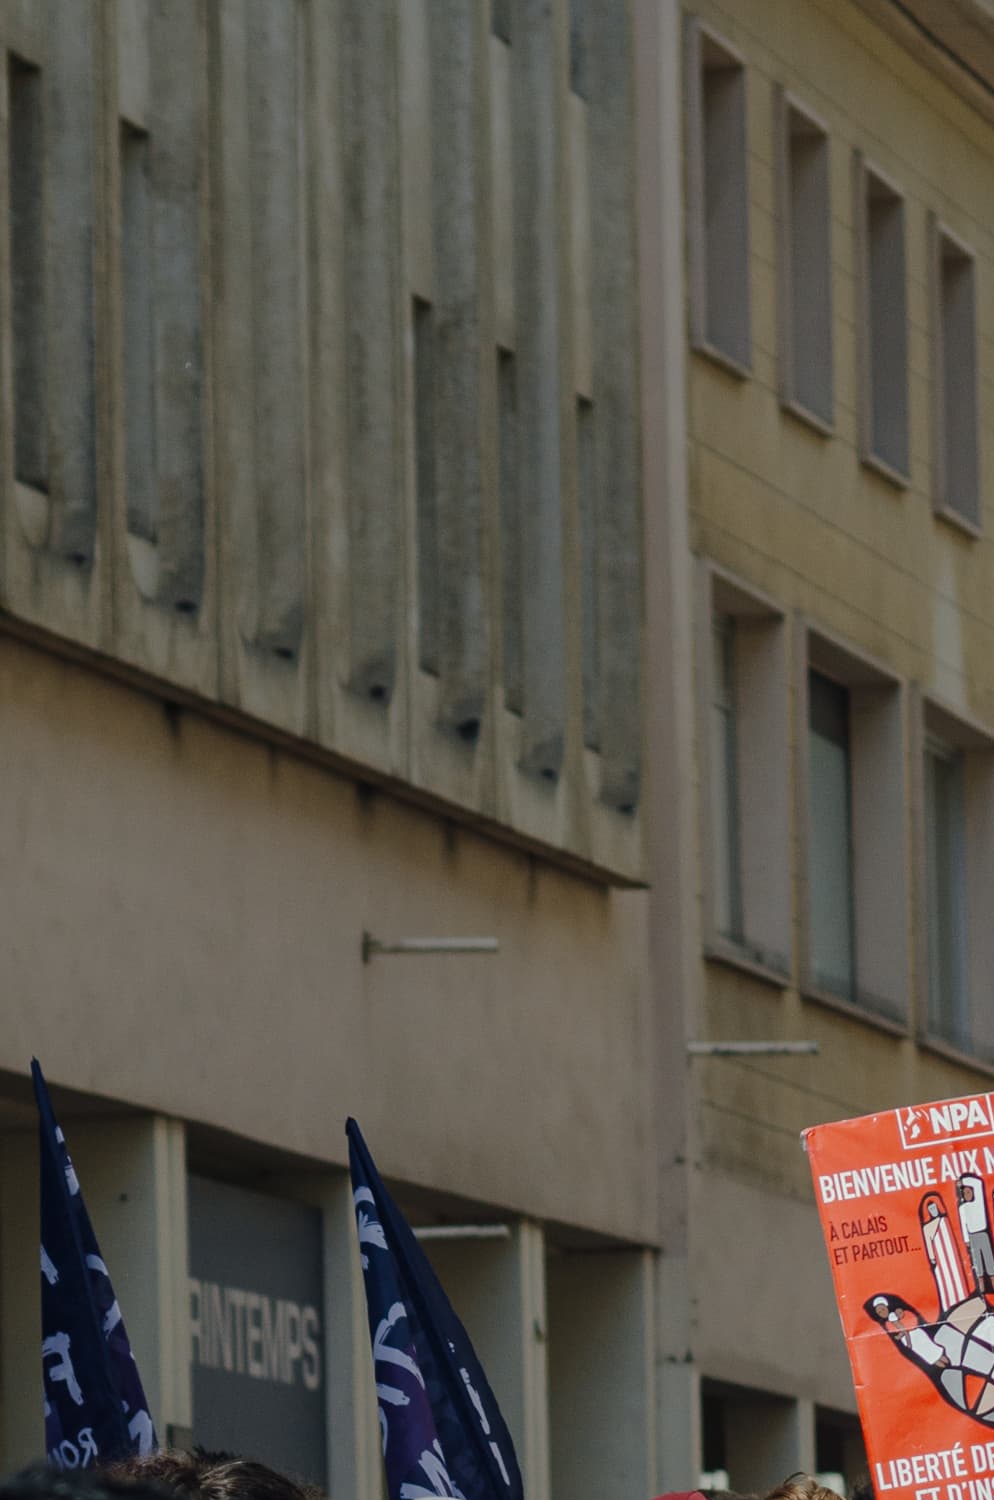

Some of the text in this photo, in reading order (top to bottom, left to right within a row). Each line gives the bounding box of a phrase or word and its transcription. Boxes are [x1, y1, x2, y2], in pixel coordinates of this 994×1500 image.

[929, 1100, 989, 1135] NPA
[819, 1157, 936, 1204] BIENVENUE
[941, 1146, 981, 1182] AUX
[829, 1216, 888, 1242] À CALAIS
[834, 1245, 850, 1266] ET
[876, 1442, 967, 1491] LIBERTÉ
